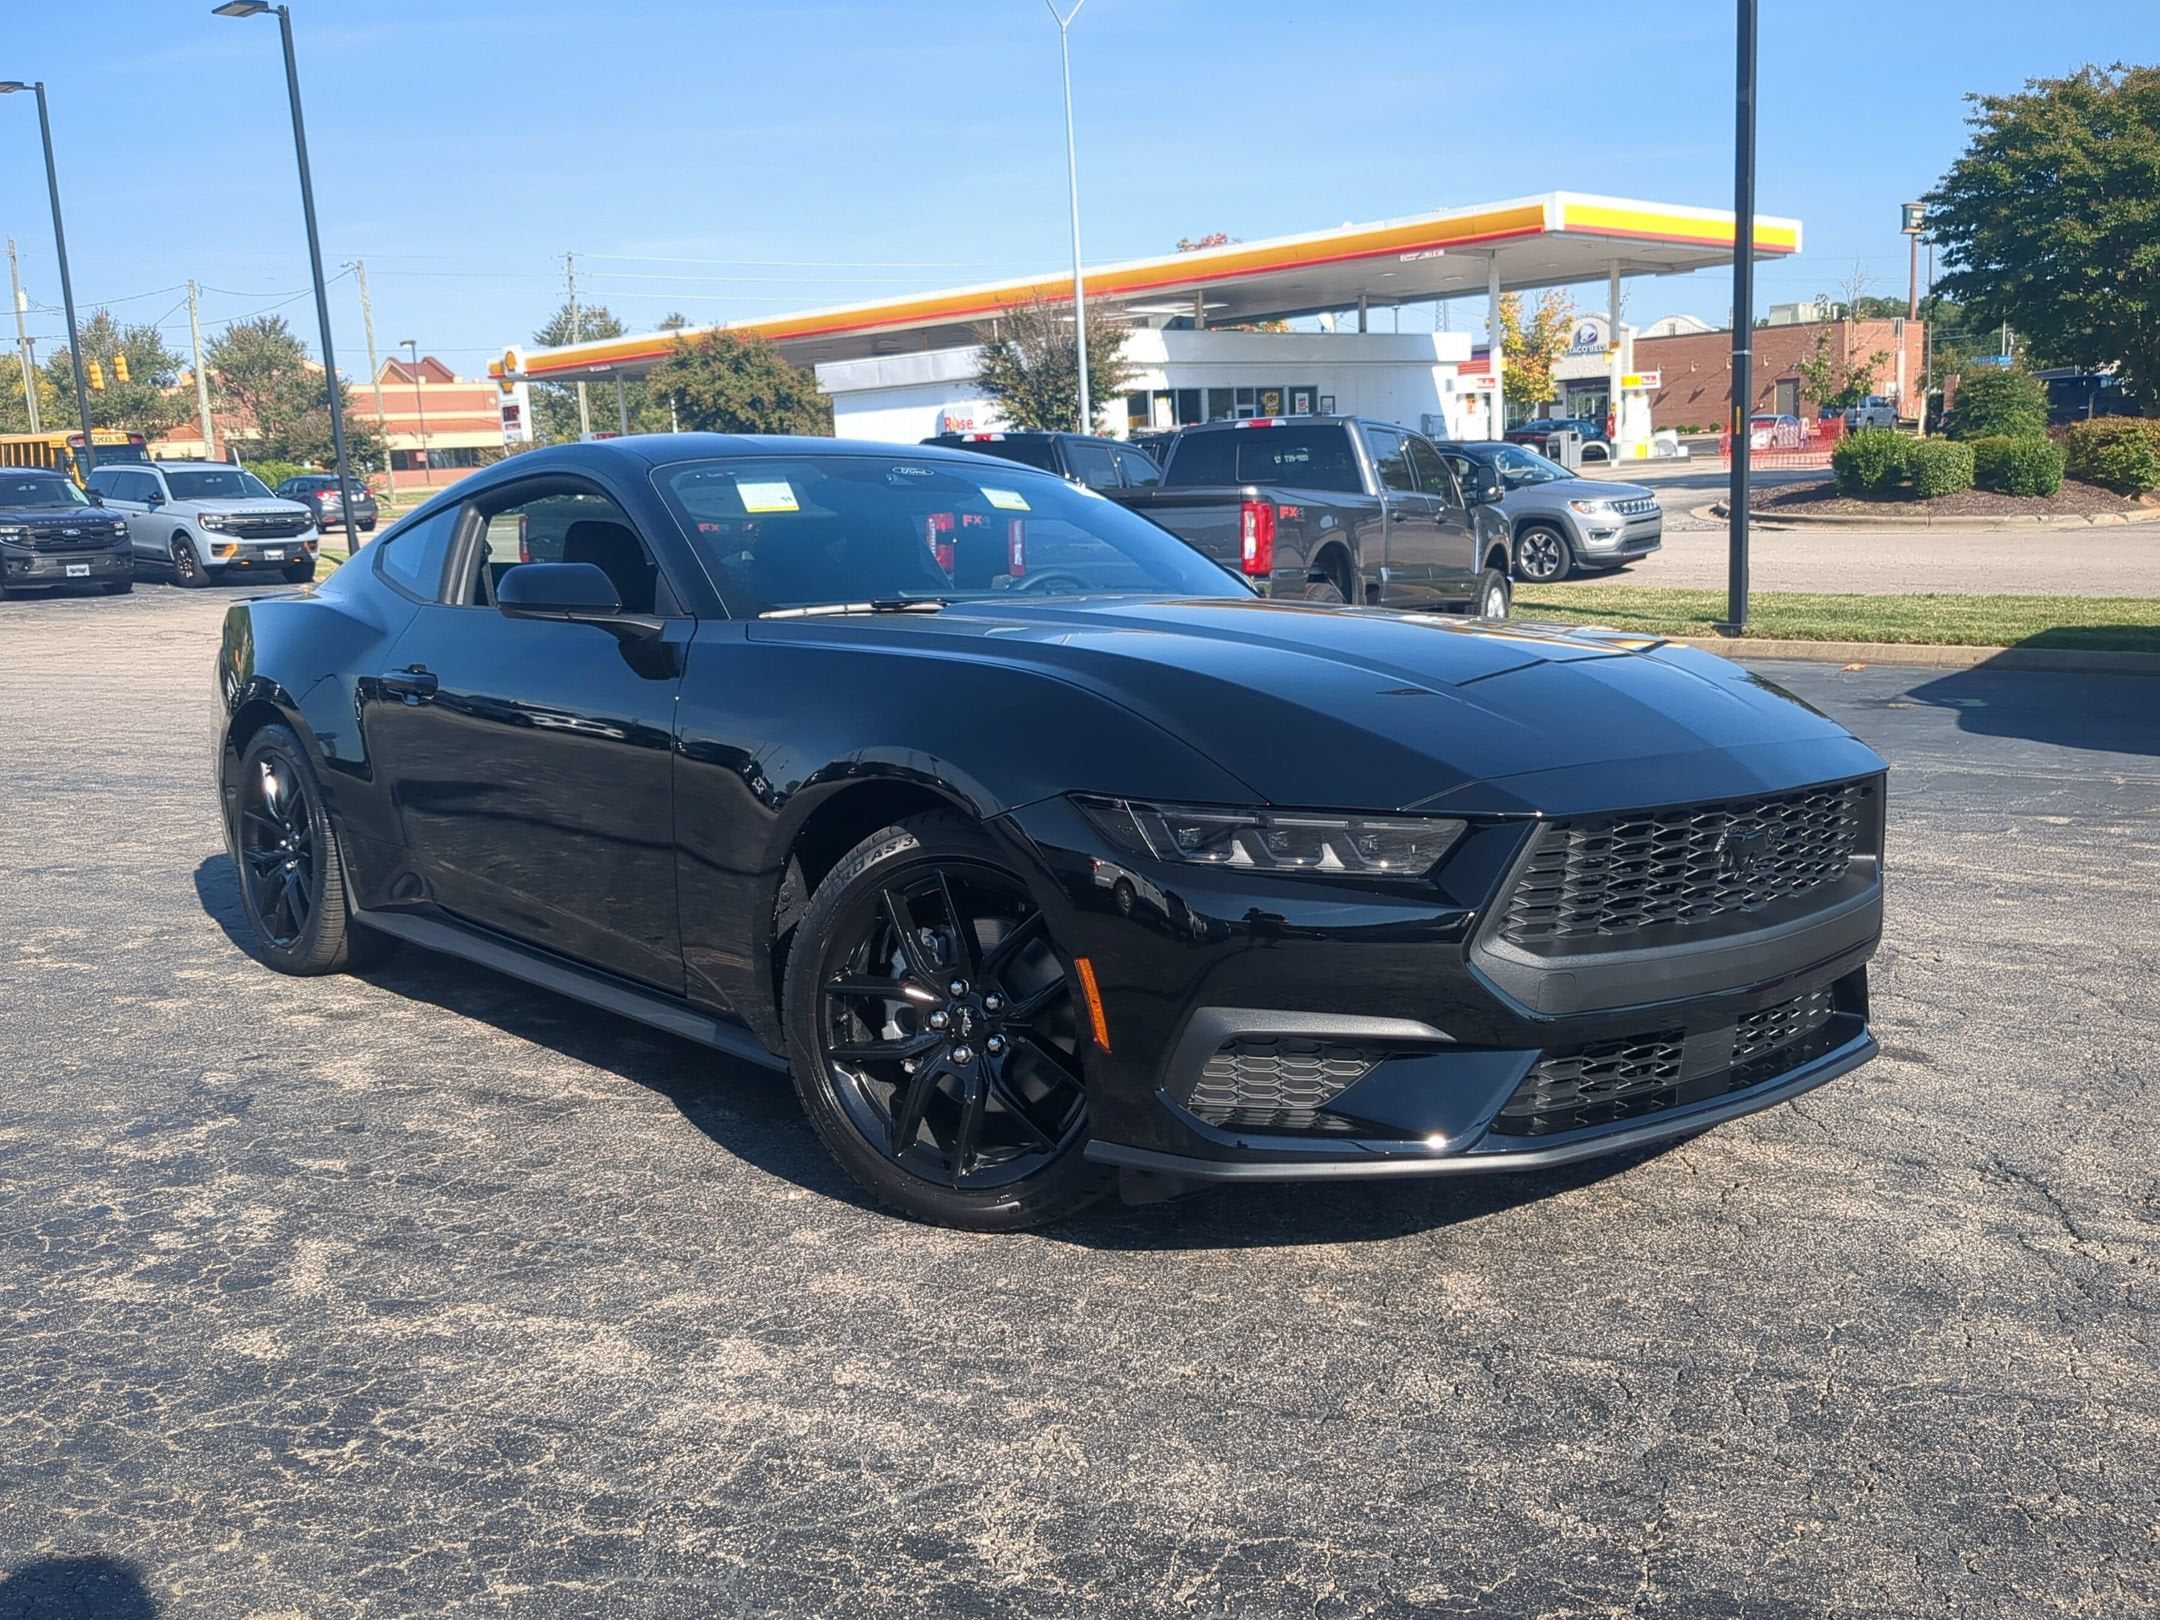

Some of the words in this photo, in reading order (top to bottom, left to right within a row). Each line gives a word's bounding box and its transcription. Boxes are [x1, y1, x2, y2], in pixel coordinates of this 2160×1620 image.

[1279, 505, 1305, 520] FX4
[871, 841, 897, 862] AS
[903, 837, 914, 847] 3
